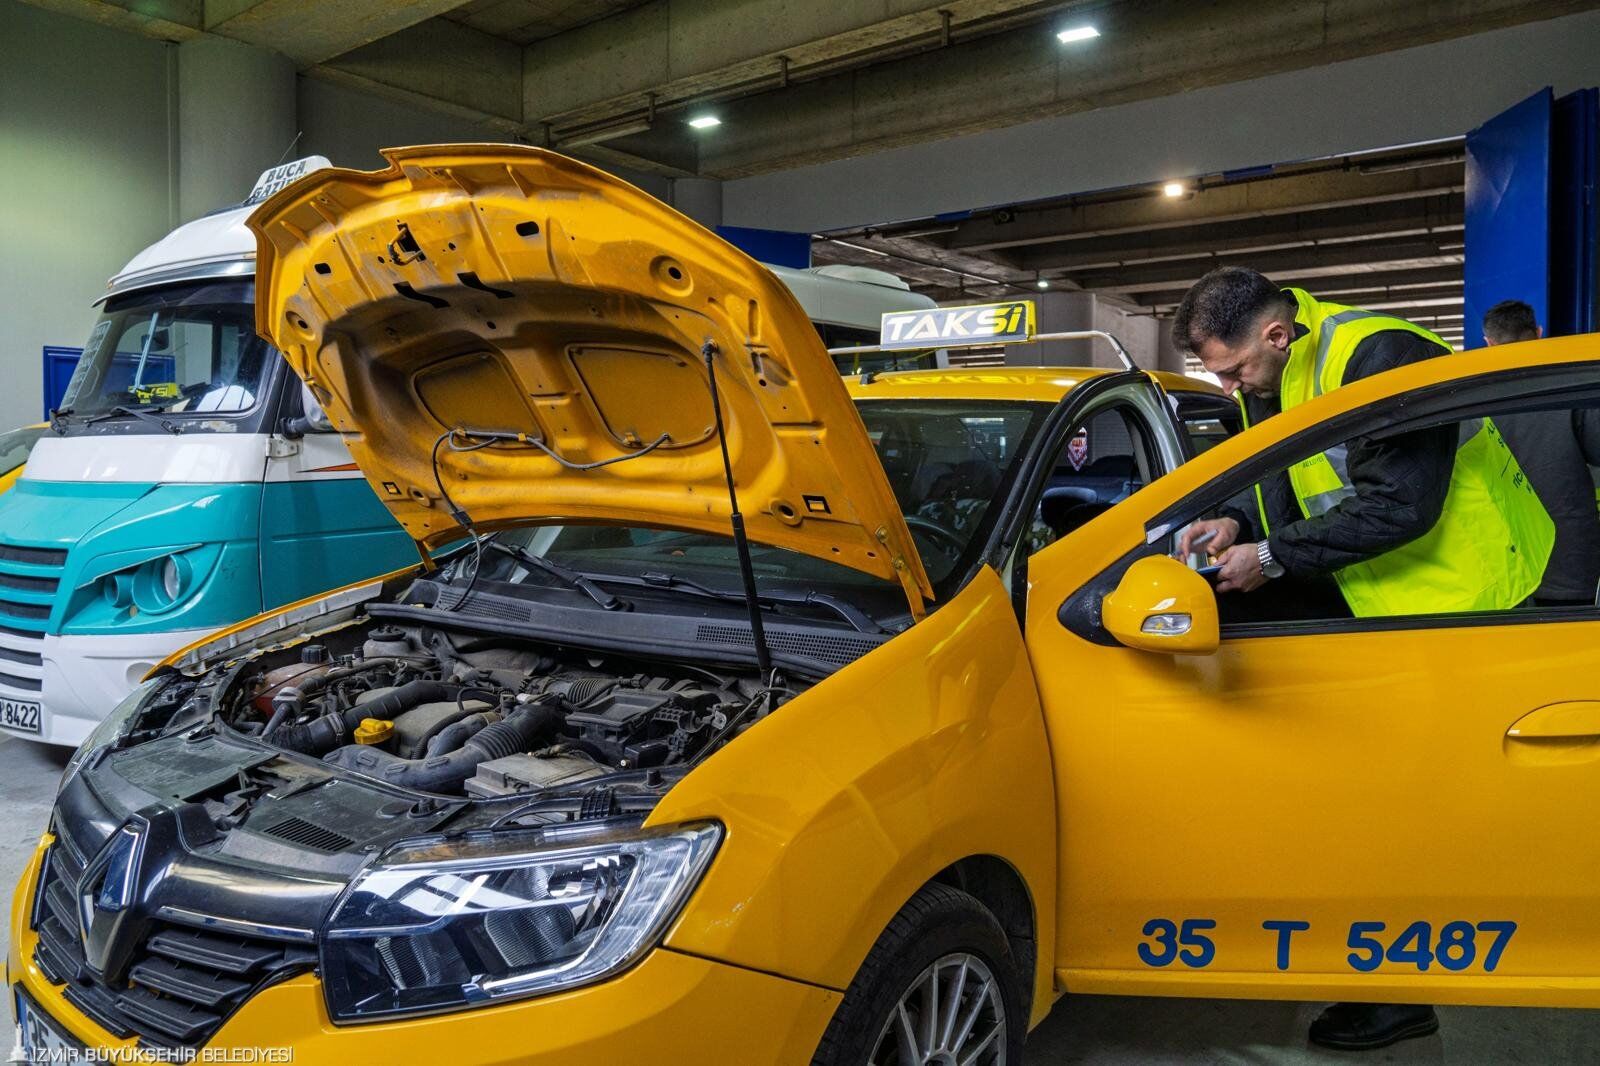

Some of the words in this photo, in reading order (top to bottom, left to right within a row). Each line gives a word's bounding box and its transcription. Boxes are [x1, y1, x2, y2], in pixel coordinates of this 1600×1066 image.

[265, 160, 307, 184] BUCA
[6, 702, 38, 729] 8422
[1137, 918, 1217, 968] 35
[1262, 920, 1310, 971] T
[1347, 920, 1518, 972] 5487
